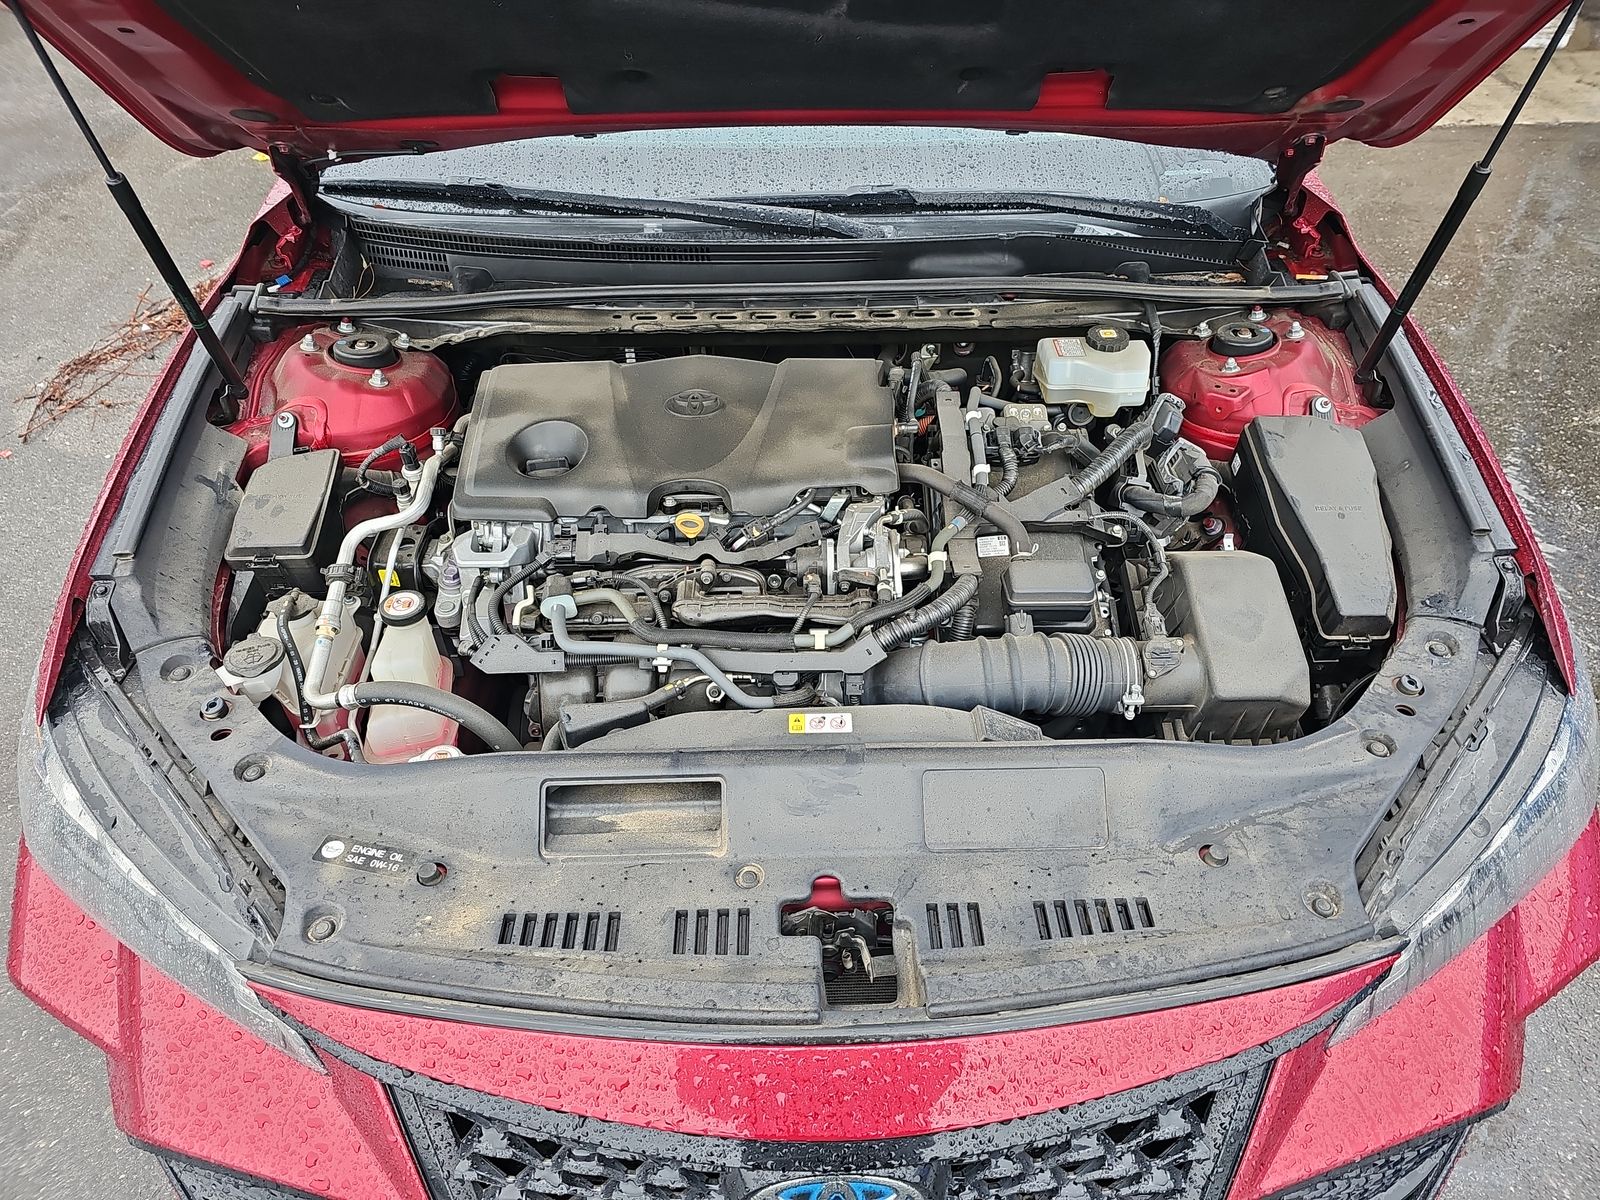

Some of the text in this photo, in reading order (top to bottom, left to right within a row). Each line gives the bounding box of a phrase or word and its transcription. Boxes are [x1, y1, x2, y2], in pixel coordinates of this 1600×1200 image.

[345, 854, 366, 866] SAE
[351, 844, 404, 863] ENGINE OIL
